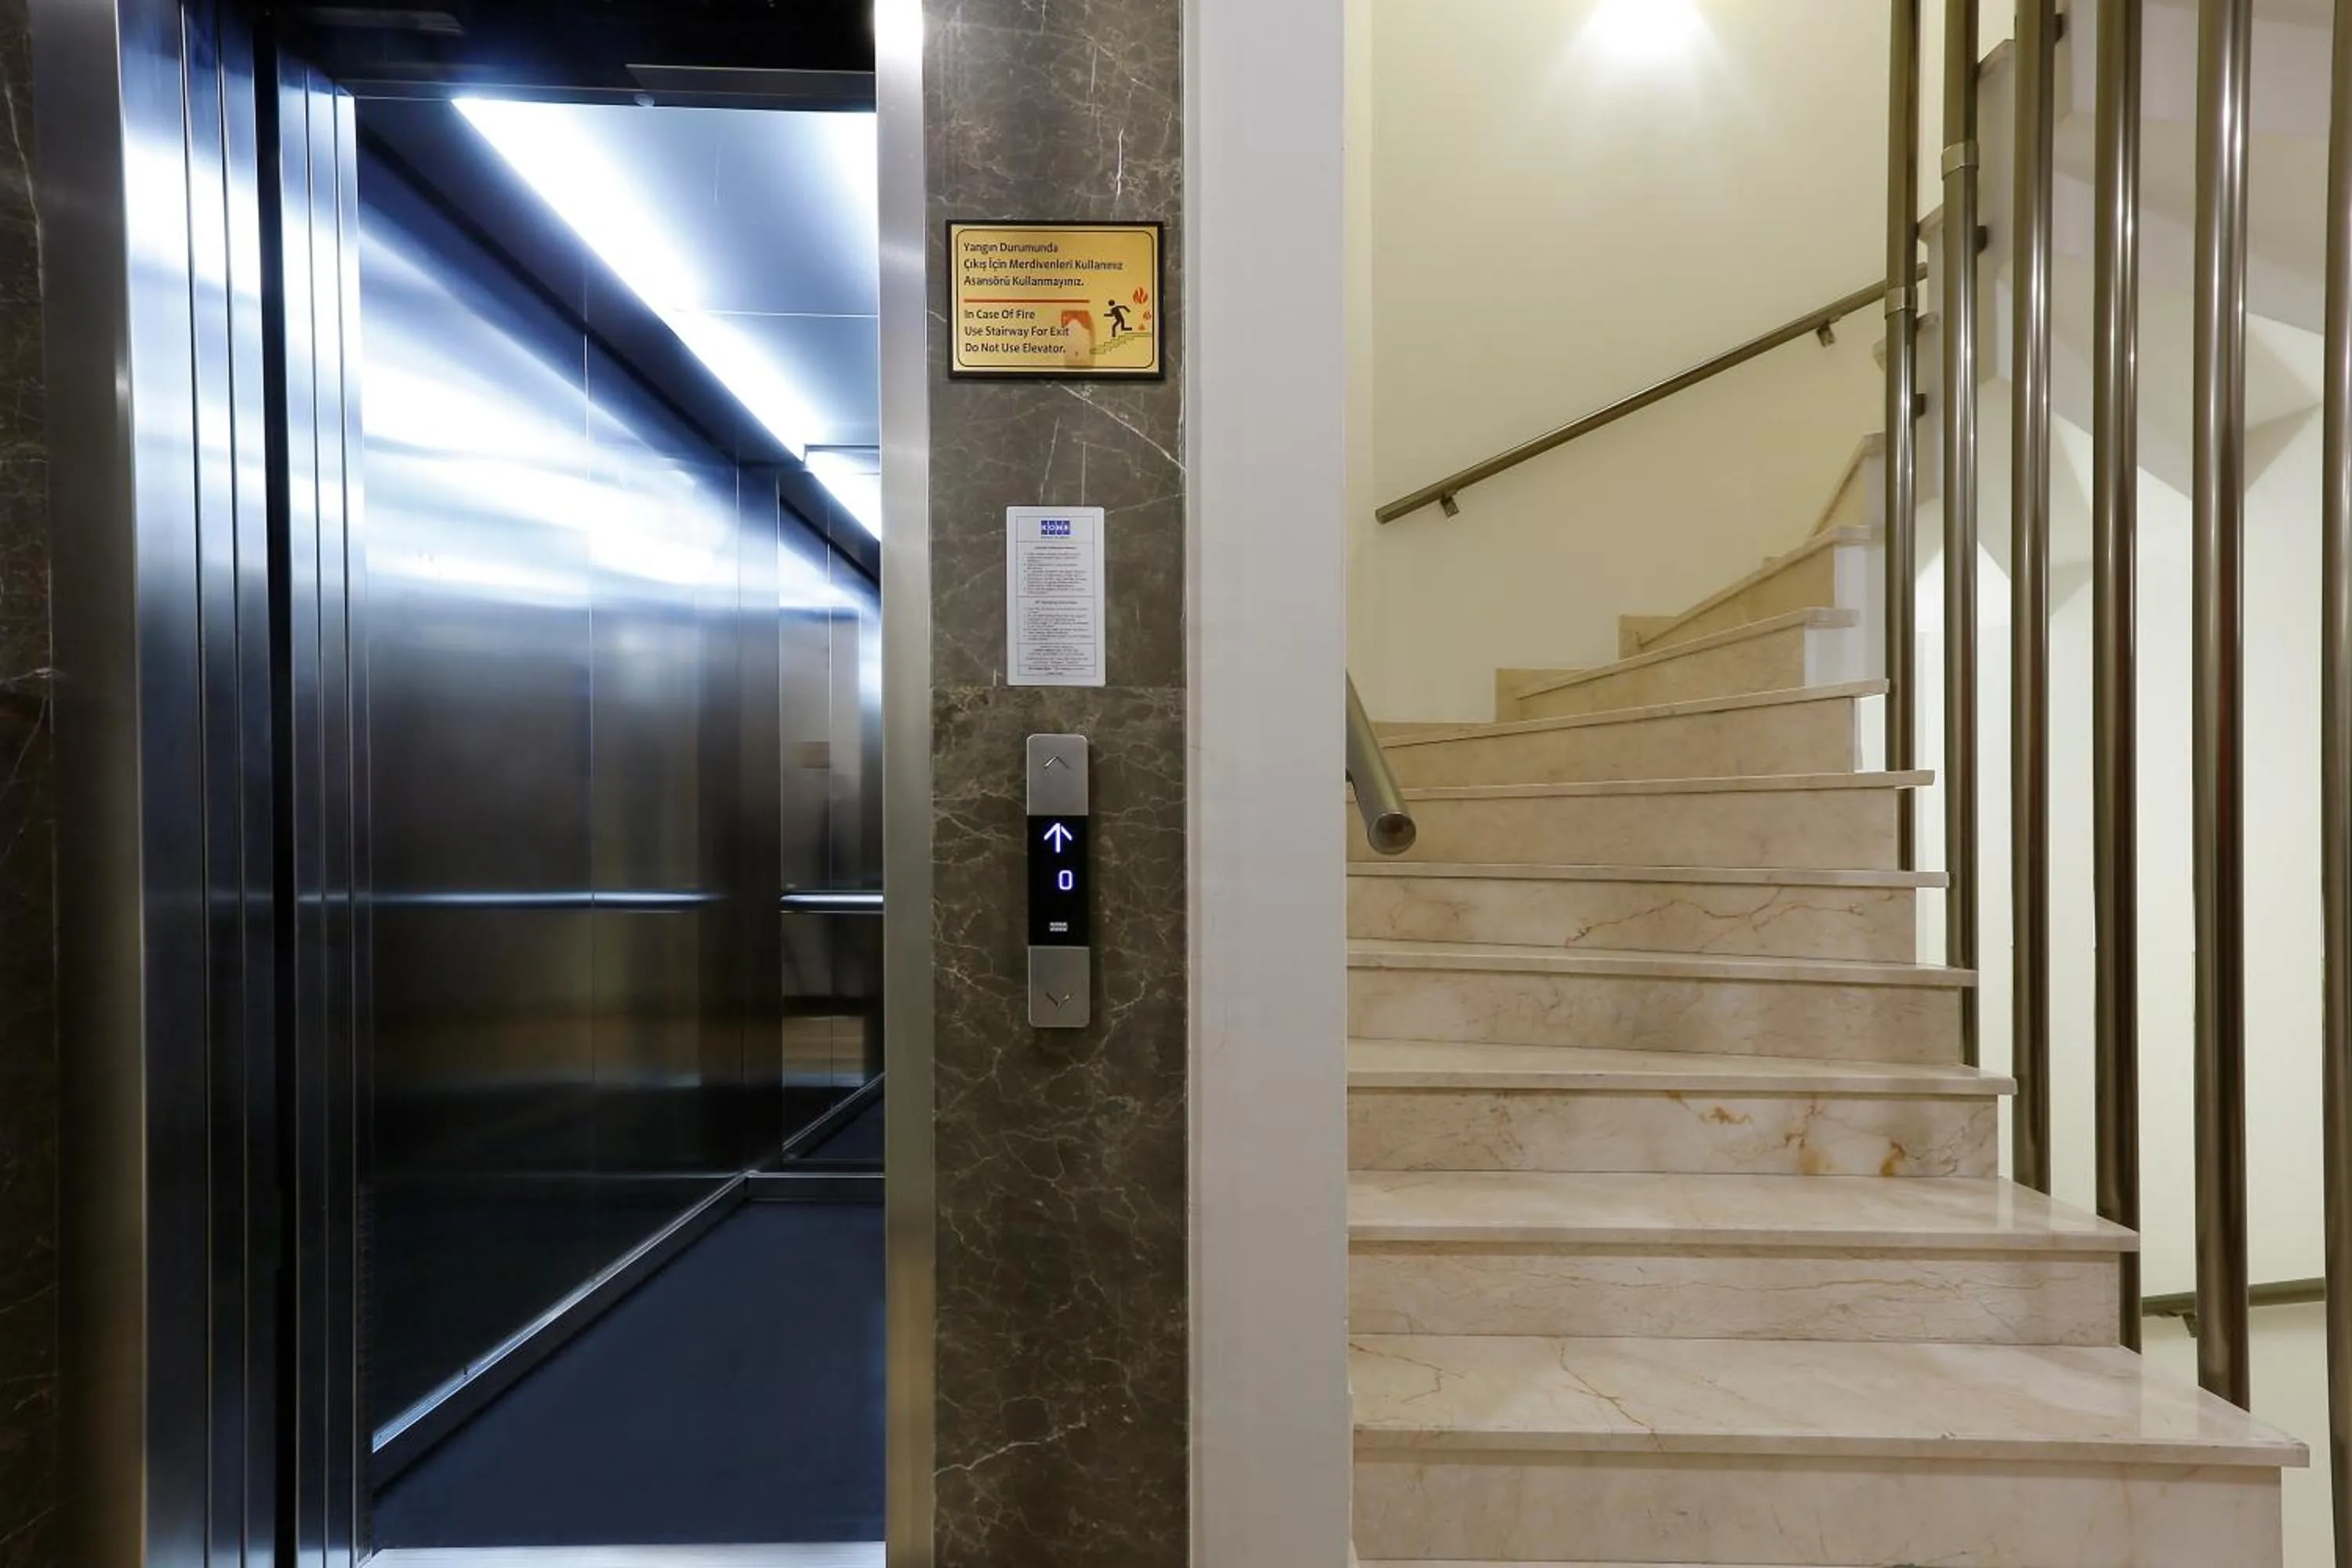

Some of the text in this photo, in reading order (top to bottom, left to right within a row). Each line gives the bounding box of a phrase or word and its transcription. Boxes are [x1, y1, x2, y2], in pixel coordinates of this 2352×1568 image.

[1000, 241, 1058, 253] Durumunda
[964, 258, 987, 271] Çıkış
[989, 256, 1007, 271] İçin
[1009, 259, 1074, 269] Merdivenleri
[964, 276, 1084, 289] Asansörü Kullanmayınız.
[964, 309, 1036, 319] In Case Of Fire
[965, 325, 1069, 339] Use Stairway For Exit
[965, 343, 1066, 354] Do Not Use Elevator.
[1058, 869, 1073, 891] 0
